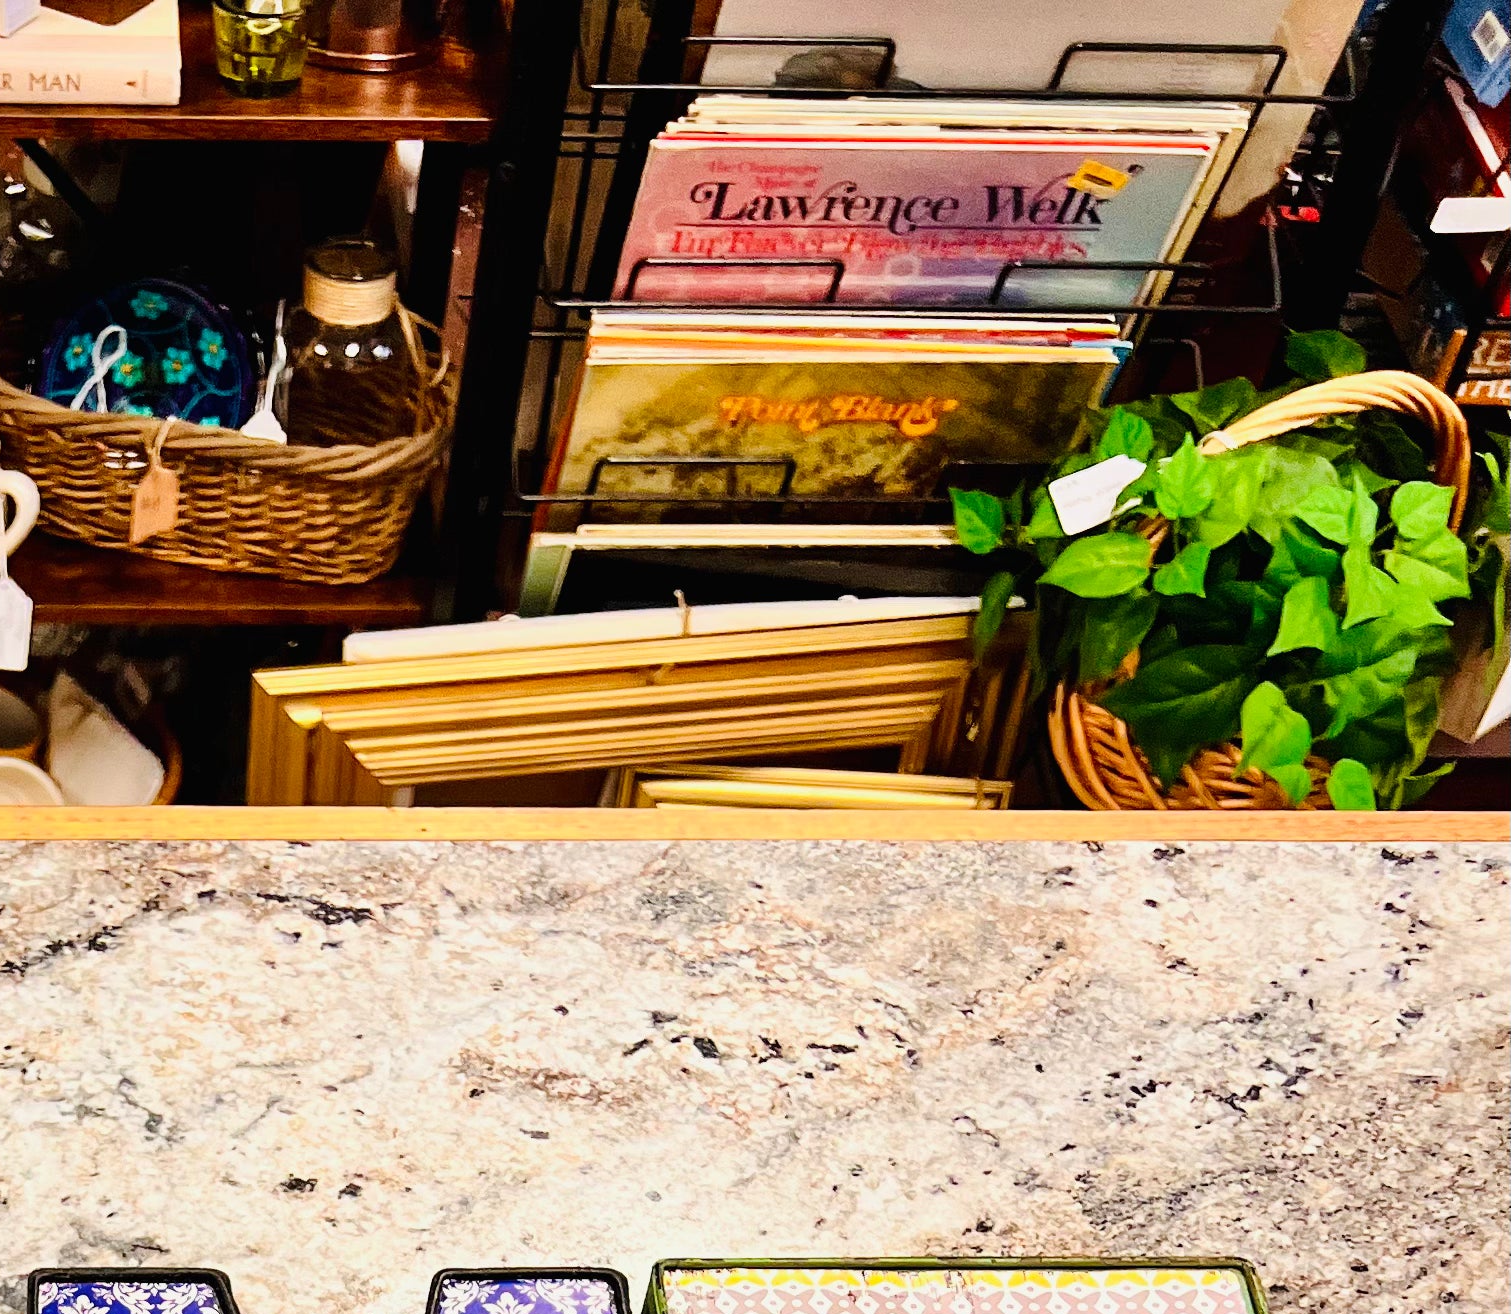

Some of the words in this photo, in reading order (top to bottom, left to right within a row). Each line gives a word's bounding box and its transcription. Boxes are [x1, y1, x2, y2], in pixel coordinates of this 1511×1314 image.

[28, 72, 81, 92] MAN
[690, 181, 959, 236] Lawrence
[983, 168, 1123, 224] Welk
